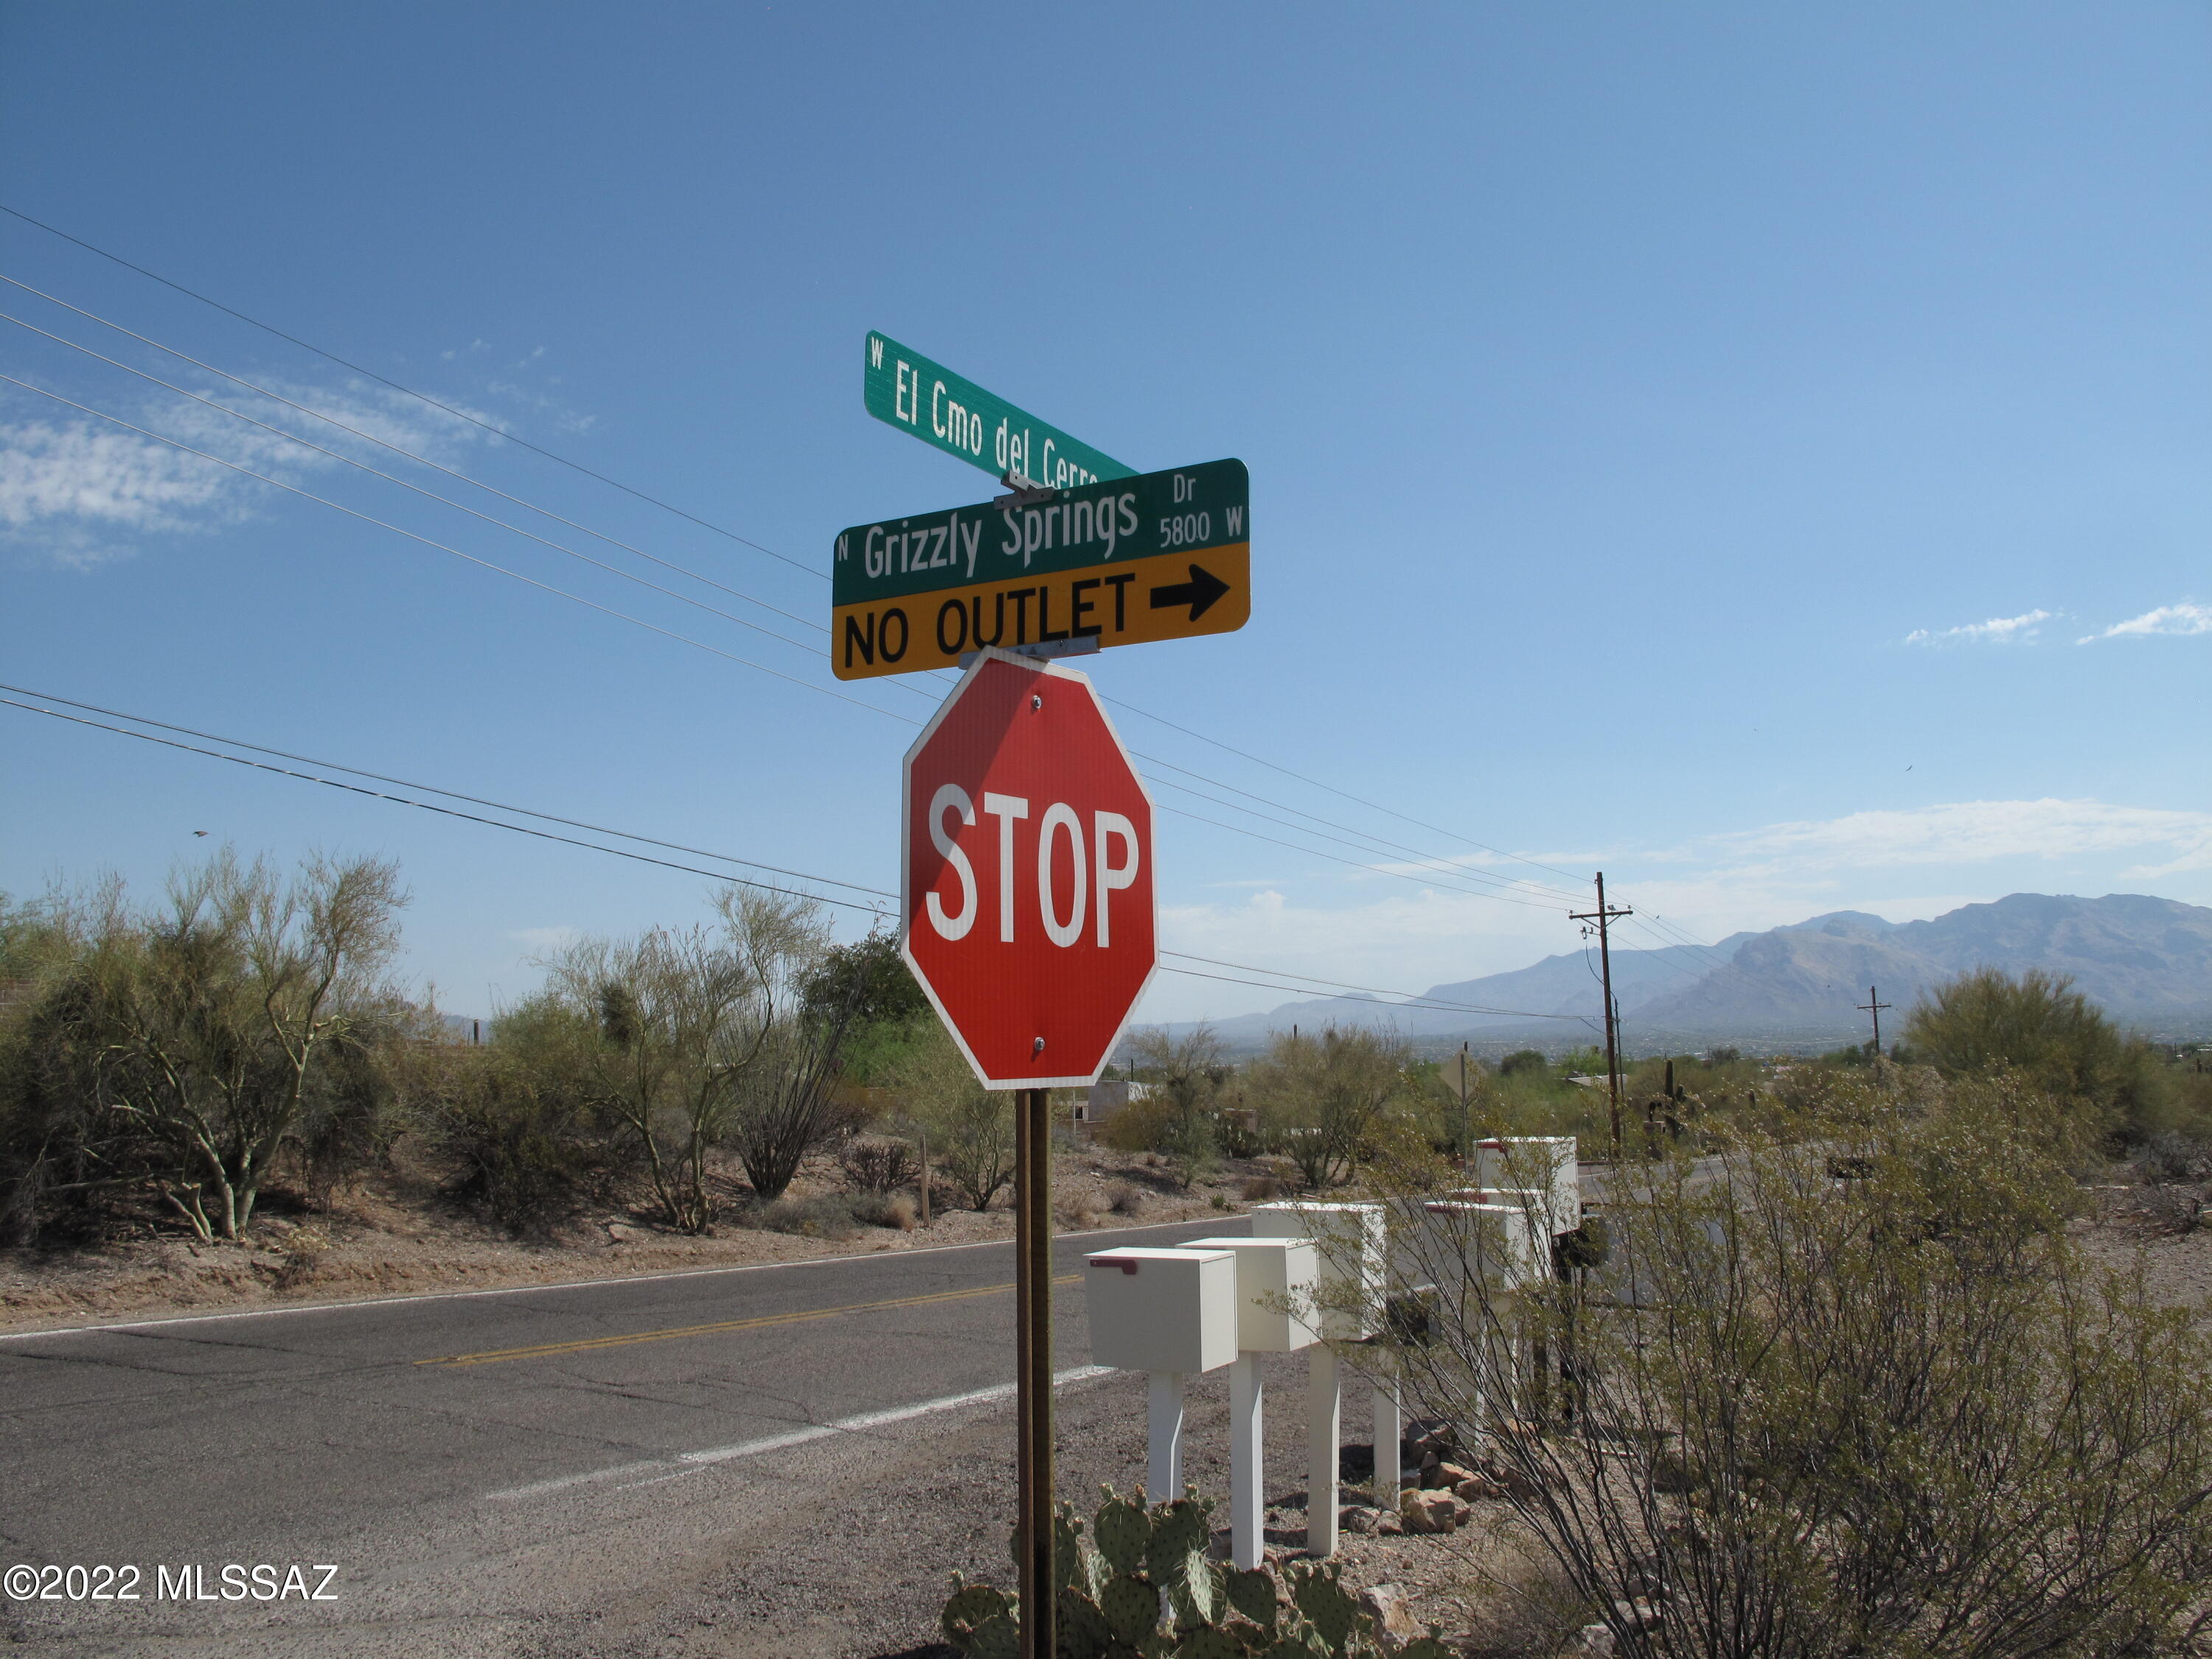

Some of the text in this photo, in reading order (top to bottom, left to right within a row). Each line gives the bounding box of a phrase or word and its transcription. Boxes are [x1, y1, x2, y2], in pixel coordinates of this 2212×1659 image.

[872, 336, 1098, 489] W El Cmo del Cerr
[838, 474, 1196, 578] N Grizzly Springs Dr
[1160, 506, 1242, 548] 5800 W
[845, 573, 1135, 668] NO OUTLET
[926, 784, 1139, 948] STOP
